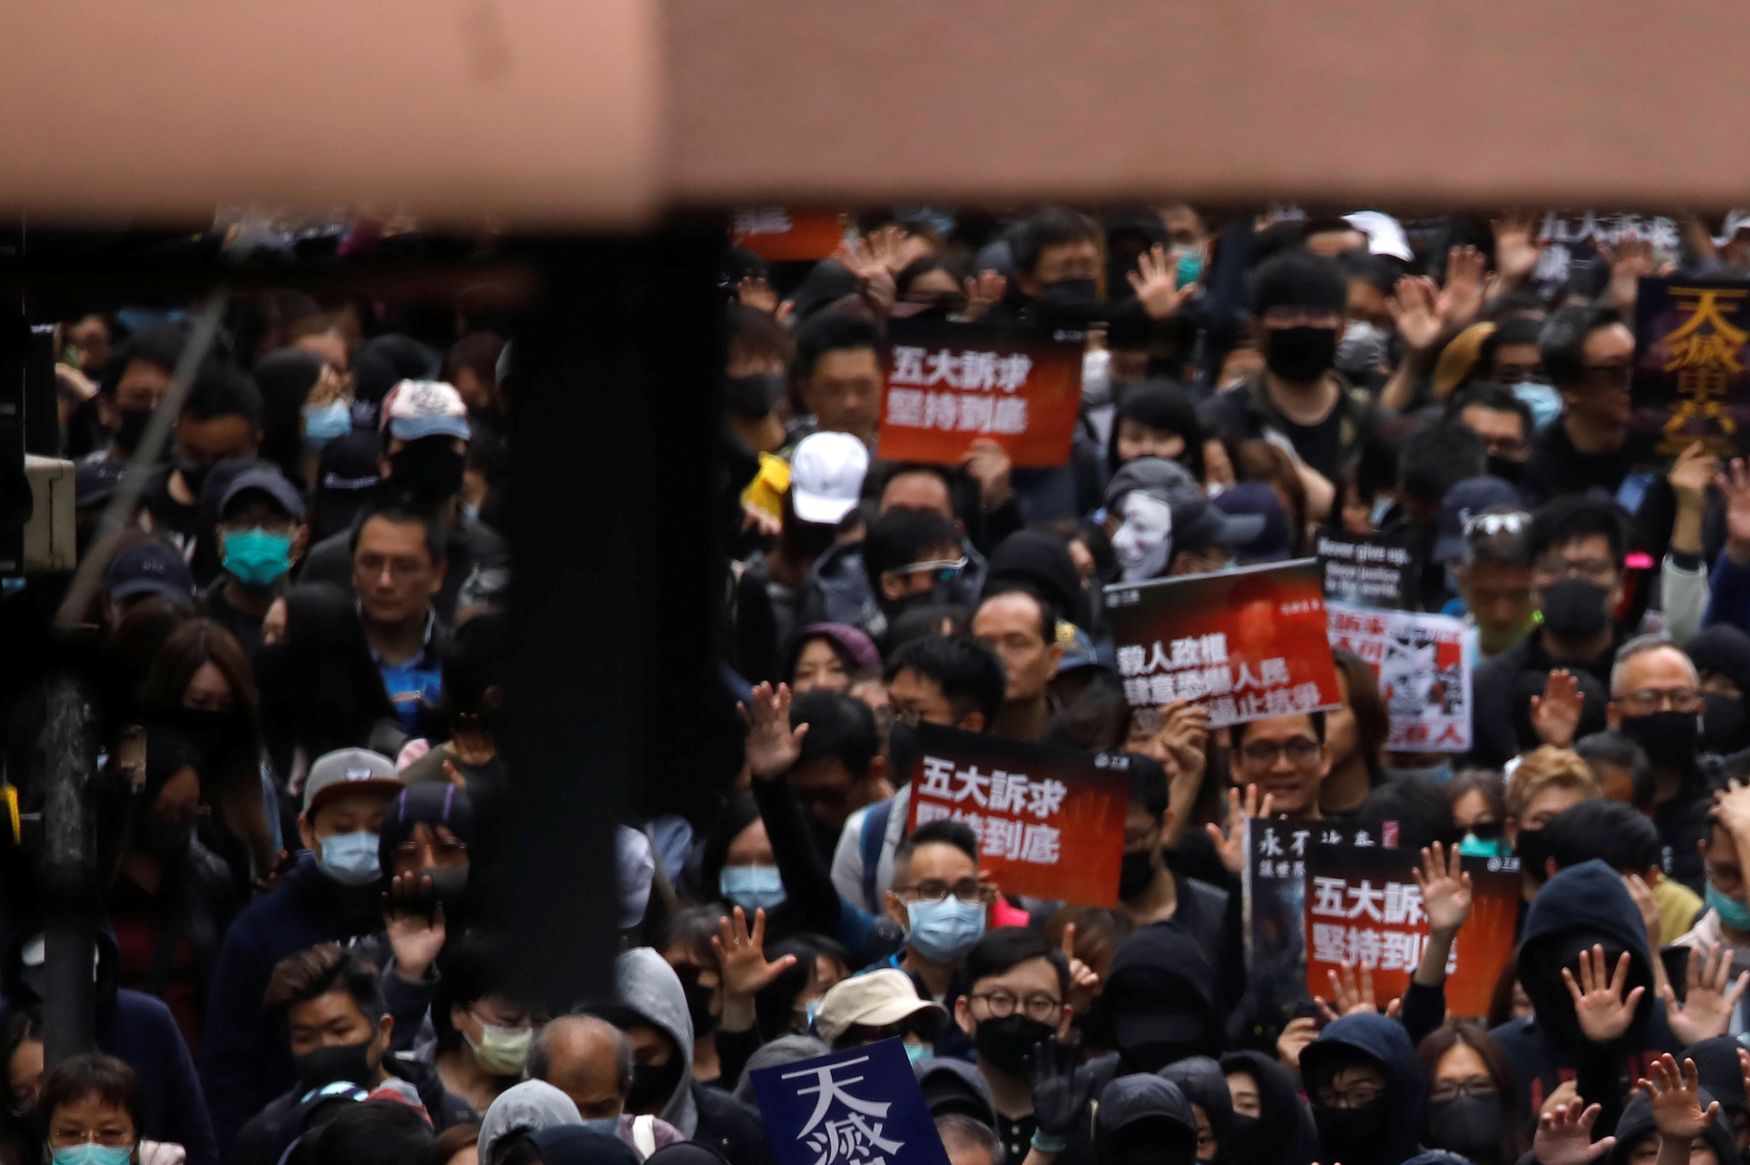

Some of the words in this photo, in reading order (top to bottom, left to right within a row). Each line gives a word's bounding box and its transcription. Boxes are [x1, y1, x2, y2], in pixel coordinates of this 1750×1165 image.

[889, 346, 1033, 393] 五大訴求
[918, 754, 1068, 819] 五大訴求
[1311, 876, 1431, 926] 五大訴
